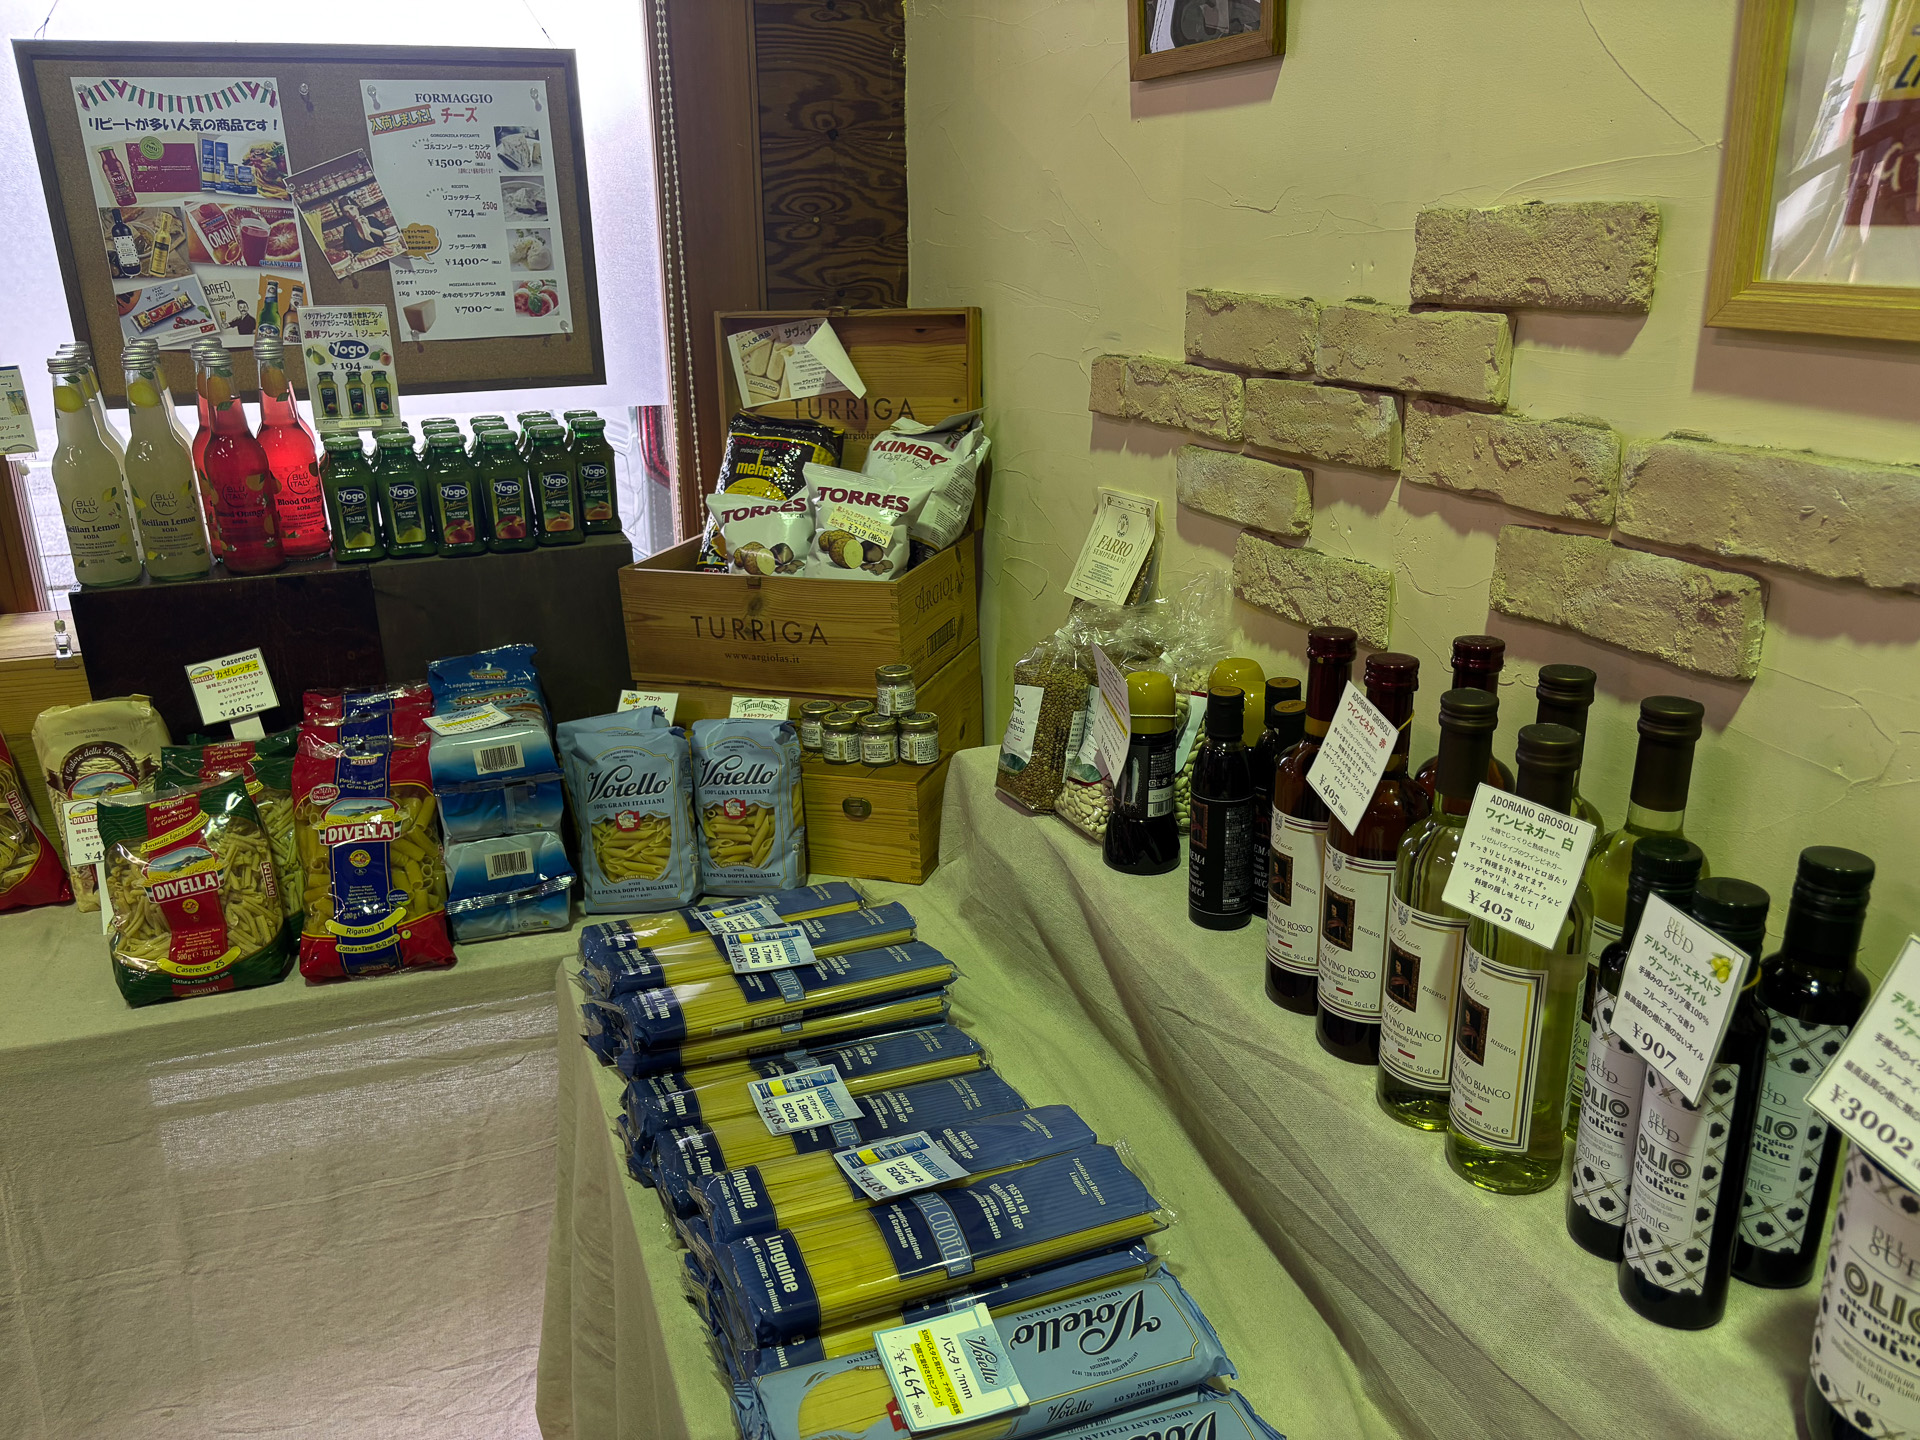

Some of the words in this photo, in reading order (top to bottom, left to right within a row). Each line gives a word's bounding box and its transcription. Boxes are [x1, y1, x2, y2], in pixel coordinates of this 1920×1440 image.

[415, 93, 493, 103] FORMAGGIO
[88, 118, 278, 132] リピートが多い人気の商品です！
[371, 109, 433, 132] 入荷しました！
[441, 107, 478, 123] チーズ
[475, 150, 492, 160] 300g
[447, 209, 475, 218] ¥724
[482, 201, 498, 210] 250g
[203, 280, 231, 295] BAFFO
[304, 329, 389, 339] 濃厚フレッシュ！ジュース
[330, 341, 367, 357] Yoga
[331, 361, 362, 372] ¥194
[792, 397, 915, 421] TURRIGA
[872, 440, 948, 466] KIMBO
[542, 475, 567, 486] Yoga
[581, 465, 605, 477] Yoga
[290, 479, 310, 488] ITALY
[389, 486, 415, 497] Yoga
[440, 486, 466, 497] Yoga
[493, 482, 519, 494] Yoga
[153, 499, 178, 508] ITALY
[277, 498, 300, 506] Blood
[338, 490, 365, 502] Yoga
[817, 486, 910, 513] TORRES
[74, 506, 99, 515] ITALY
[170, 516, 196, 526] Lemon
[722, 497, 807, 524] TORRES
[92, 523, 121, 532] Lemon
[1096, 534, 1134, 558] FARRO
[914, 565, 965, 624] ARGIOLAS
[691, 616, 828, 645] TURRIGA
[221, 652, 258, 667] Caserecce
[724, 650, 800, 664] www.argiolas.it
[215, 663, 259, 679] カゼレッチェ
[220, 703, 253, 717] ¥405
[1347, 700, 1378, 738] ワインビネガー
[1352, 692, 1373, 716] ADORIANO
[1372, 713, 1391, 737] GROSOLI
[699, 755, 777, 788] Voiello
[587, 765, 671, 804] Voiello
[717, 788, 738, 796] GRANI
[1319, 774, 1340, 806] ¥405
[8, 791, 28, 822] DIVELLA
[153, 813, 167, 823] Pasta
[173, 805, 193, 816] Semola
[608, 801, 631, 809] GRANI
[632, 797, 665, 807] ITALIANI
[1490, 794, 1535, 818] ADORIANO
[1537, 812, 1579, 835] GROSOLI
[161, 817, 178, 826] Grano
[179, 811, 193, 821] Duro
[1485, 807, 1556, 841] ワインビネガー
[1561, 837, 1574, 852] 白
[328, 823, 392, 842] DIVELLA
[1470, 841, 1568, 886] すっきりとした味わいと口当たり
[1478, 857, 1548, 890] で料理を引き立てます。
[154, 873, 217, 900] DIVELLA
[263, 863, 275, 896] DIVELLA
[646, 883, 678, 891] RIGATURA
[1295, 881, 1317, 895] RISERVA
[1332, 875, 1356, 893] Duca
[1463, 861, 1562, 908] サラダやマリネ、カポナータなど
[1468, 889, 1514, 923] ¥405
[1514, 916, 1535, 931] (税込)
[346, 926, 375, 935] Rigatoni
[377, 922, 385, 930] 17
[1287, 920, 1314, 934] ROSSO
[1357, 925, 1381, 939] RISERVA
[1396, 929, 1422, 950] Duca
[175, 965, 211, 974] Caserecce
[214, 960, 225, 969] 25
[1347, 966, 1376, 980] ROSSO
[1644, 933, 1722, 998] デルスッド・エキストラ
[1466, 977, 1490, 1001] Duca
[1648, 955, 1707, 1007] ヴァージンオイル
[1422, 985, 1447, 1001] RISERVA
[1638, 965, 1710, 1027] 手摘みのイタリア産100%
[1643, 986, 1696, 1033] フルーティーな香り
[1406, 1026, 1442, 1043] BIANCO
[1623, 990, 1705, 1062] 最高品質の他に類のないオイル
[1490, 1038, 1517, 1056] RISERVA
[1631, 1021, 1678, 1070] ¥907
[1473, 1079, 1511, 1100] BIANCO
[1583, 1077, 1630, 1118] OLIO
[762, 1099, 786, 1125] ¥448
[782, 1102, 799, 1124] 500g
[796, 1098, 814, 1122] 1.9mm
[1829, 1083, 1914, 1160] ¥3002
[958, 1130, 974, 1146] PASTA
[1588, 1115, 1626, 1139] oliva
[1638, 1133, 1692, 1179] OLIO
[856, 1169, 888, 1193] ¥448
[896, 1160, 925, 1183] リングイネ
[1005, 1183, 1025, 1205] PASTA
[1069, 1171, 1088, 1196] Linguine
[1645, 1174, 1687, 1201] oliva
[989, 1183, 1014, 1214] GRAGNANO
[1010, 1213, 1024, 1230] IGP
[928, 1211, 967, 1260] CUORE
[764, 1235, 799, 1293] Linguine
[767, 1286, 783, 1313] minuti
[1009, 1289, 1161, 1355] Voiello
[1016, 1303, 1062, 1321] ITALIANI
[941, 1336, 960, 1364] パスタ
[954, 1367, 973, 1399] 1.7mm
[965, 1335, 998, 1386] Voiello
[894, 1350, 926, 1400] ¥464
[1114, 1395, 1124, 1403] LO
[1125, 1380, 1179, 1399] SPAGHETTINO
[1047, 1397, 1094, 1424] Voiello
